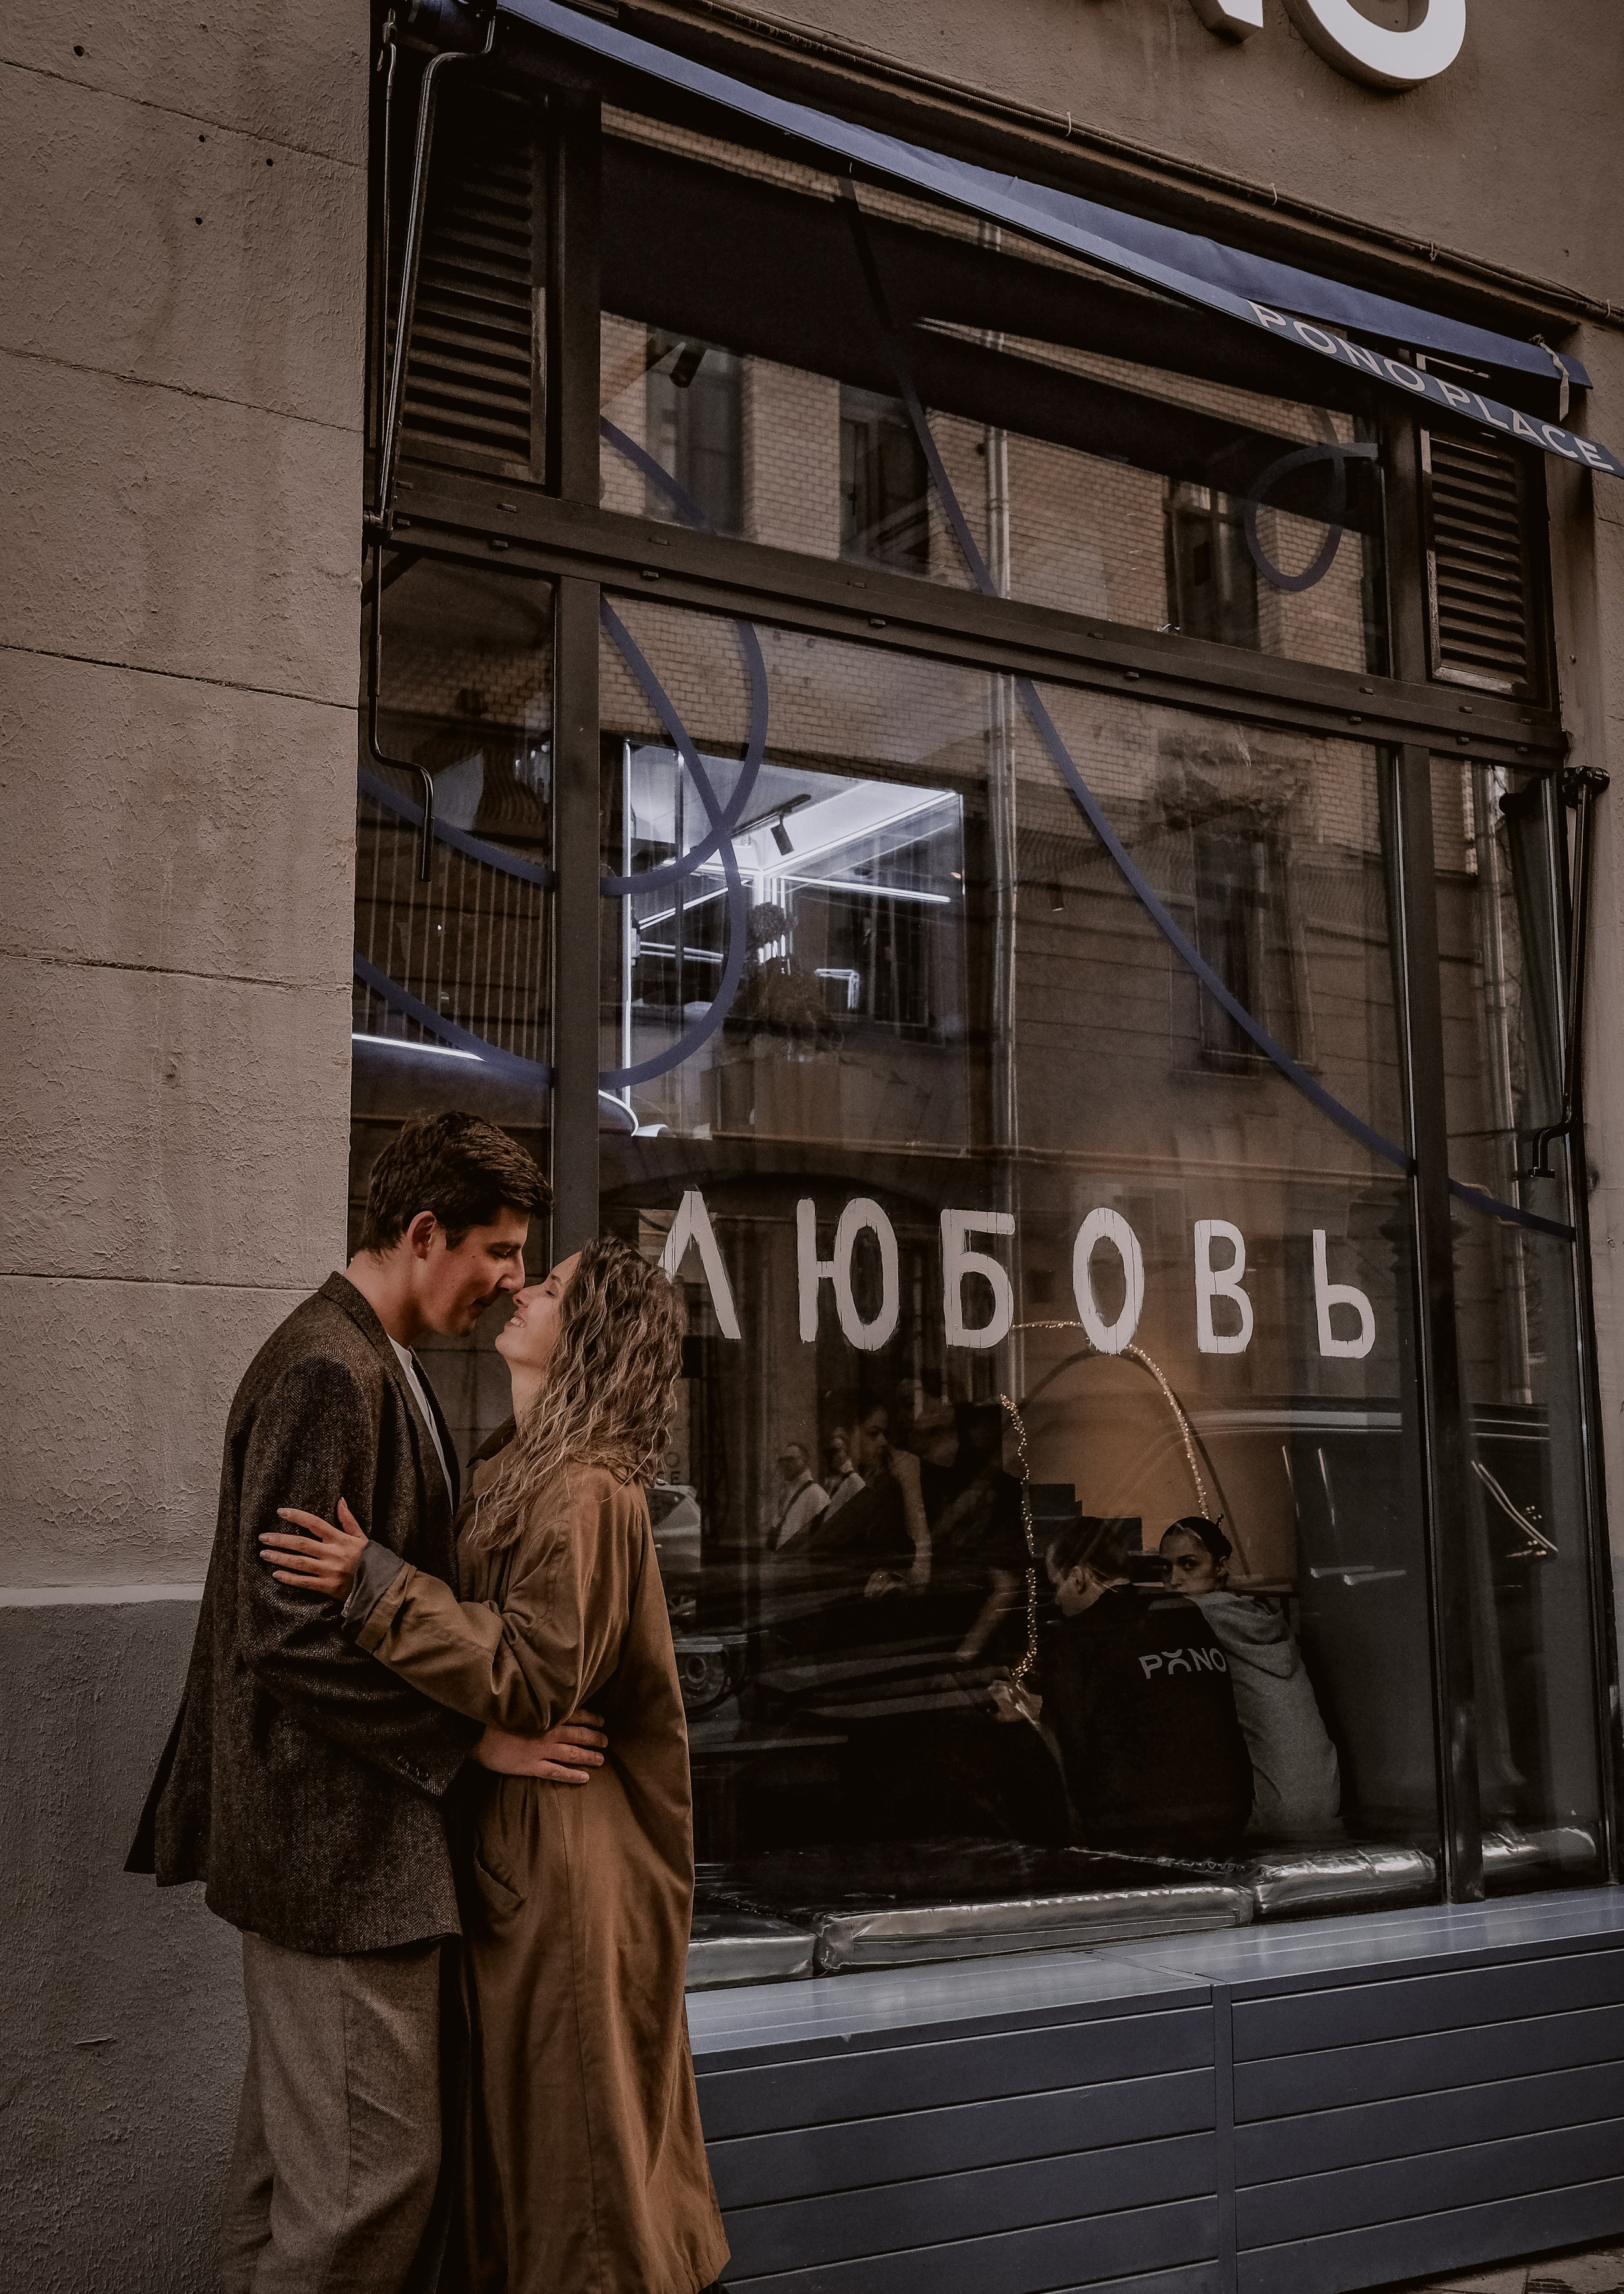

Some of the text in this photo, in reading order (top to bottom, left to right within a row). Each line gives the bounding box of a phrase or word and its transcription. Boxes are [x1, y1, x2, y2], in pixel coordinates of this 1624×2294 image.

[1246, 298, 1615, 471] PONO PLACE
[658, 1188, 1377, 1359] ЛЮБОВЬ
